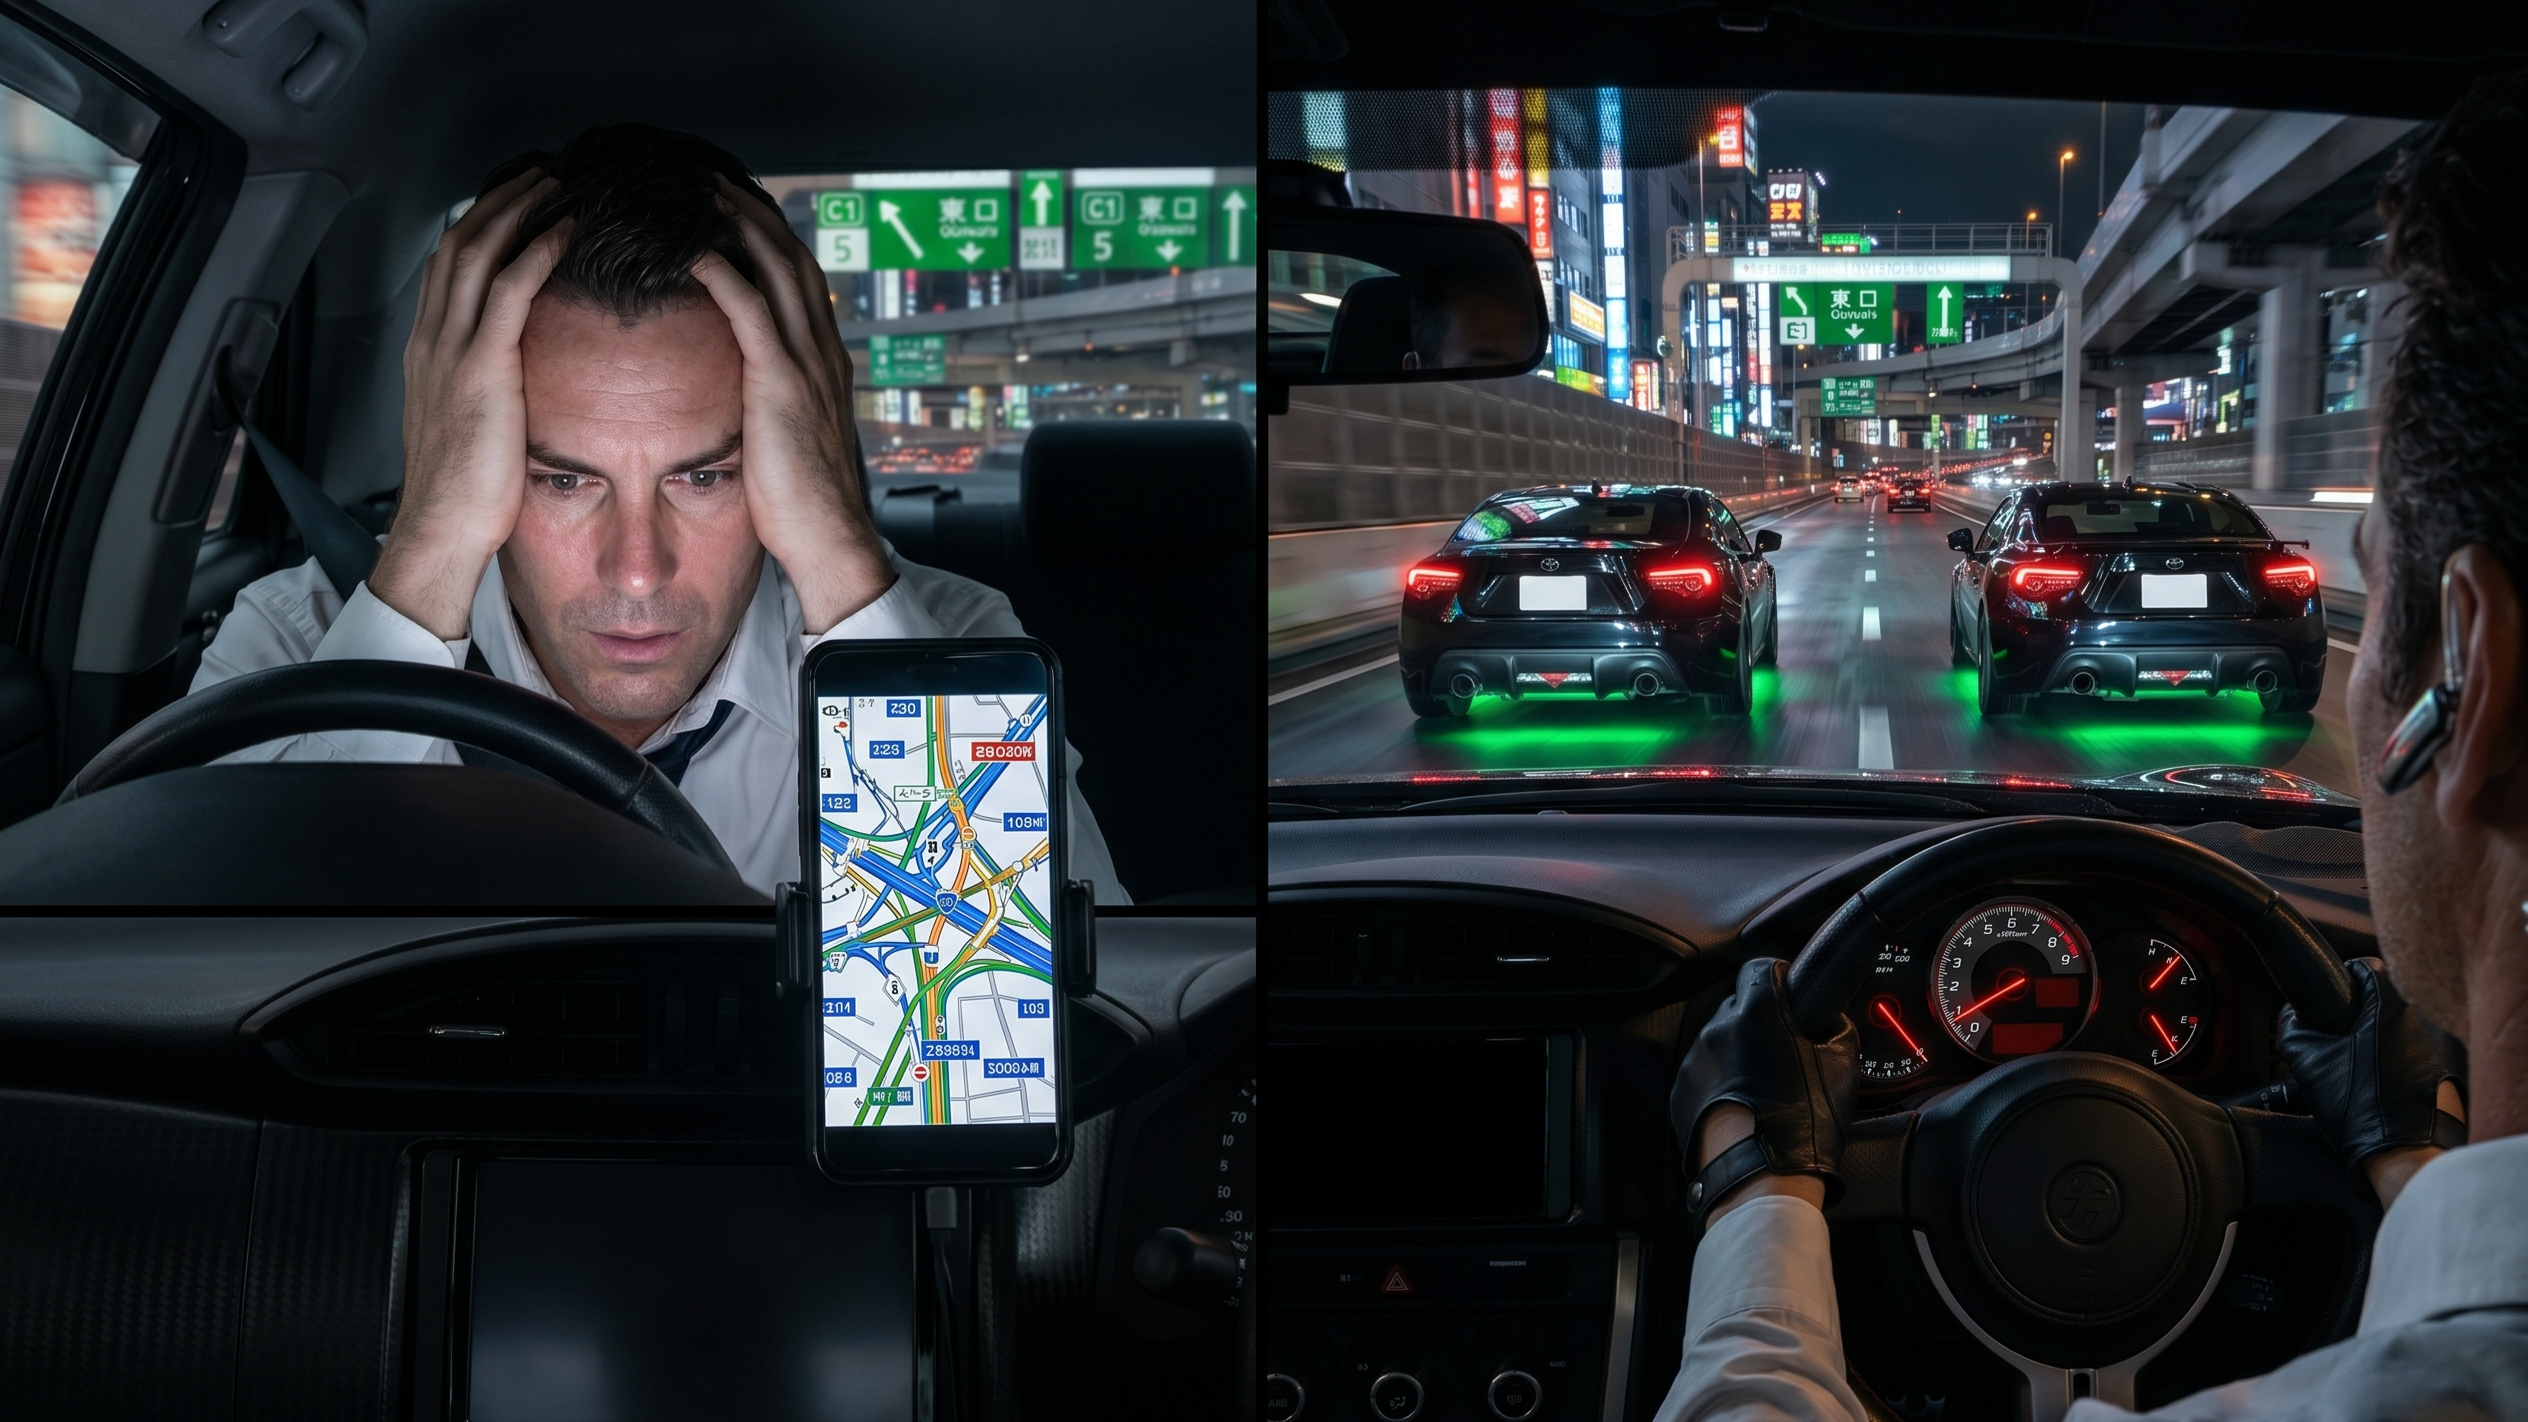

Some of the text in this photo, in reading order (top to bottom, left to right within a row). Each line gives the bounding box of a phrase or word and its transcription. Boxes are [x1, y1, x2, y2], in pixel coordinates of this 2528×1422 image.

[827, 199, 856, 222] C1
[939, 197, 998, 223] 東口
[1085, 196, 1119, 220] C1
[834, 235, 852, 263] 5
[1094, 232, 1113, 261] 5
[1831, 289, 1877, 309] 東口
[2007, 917, 2017, 929] 6
[2031, 923, 2040, 935] 7
[1983, 924, 1993, 935] 5
[1963, 936, 1973, 947] 4
[2047, 936, 2058, 948] 8
[1952, 957, 1962, 969] 3
[2061, 954, 2070, 966] 9
[1949, 981, 1960, 992] 2
[2180, 976, 2188, 985] E
[2180, 1015, 2188, 1024] E
[1970, 1022, 1980, 1033] 0
[2151, 1049, 2159, 1058] E
